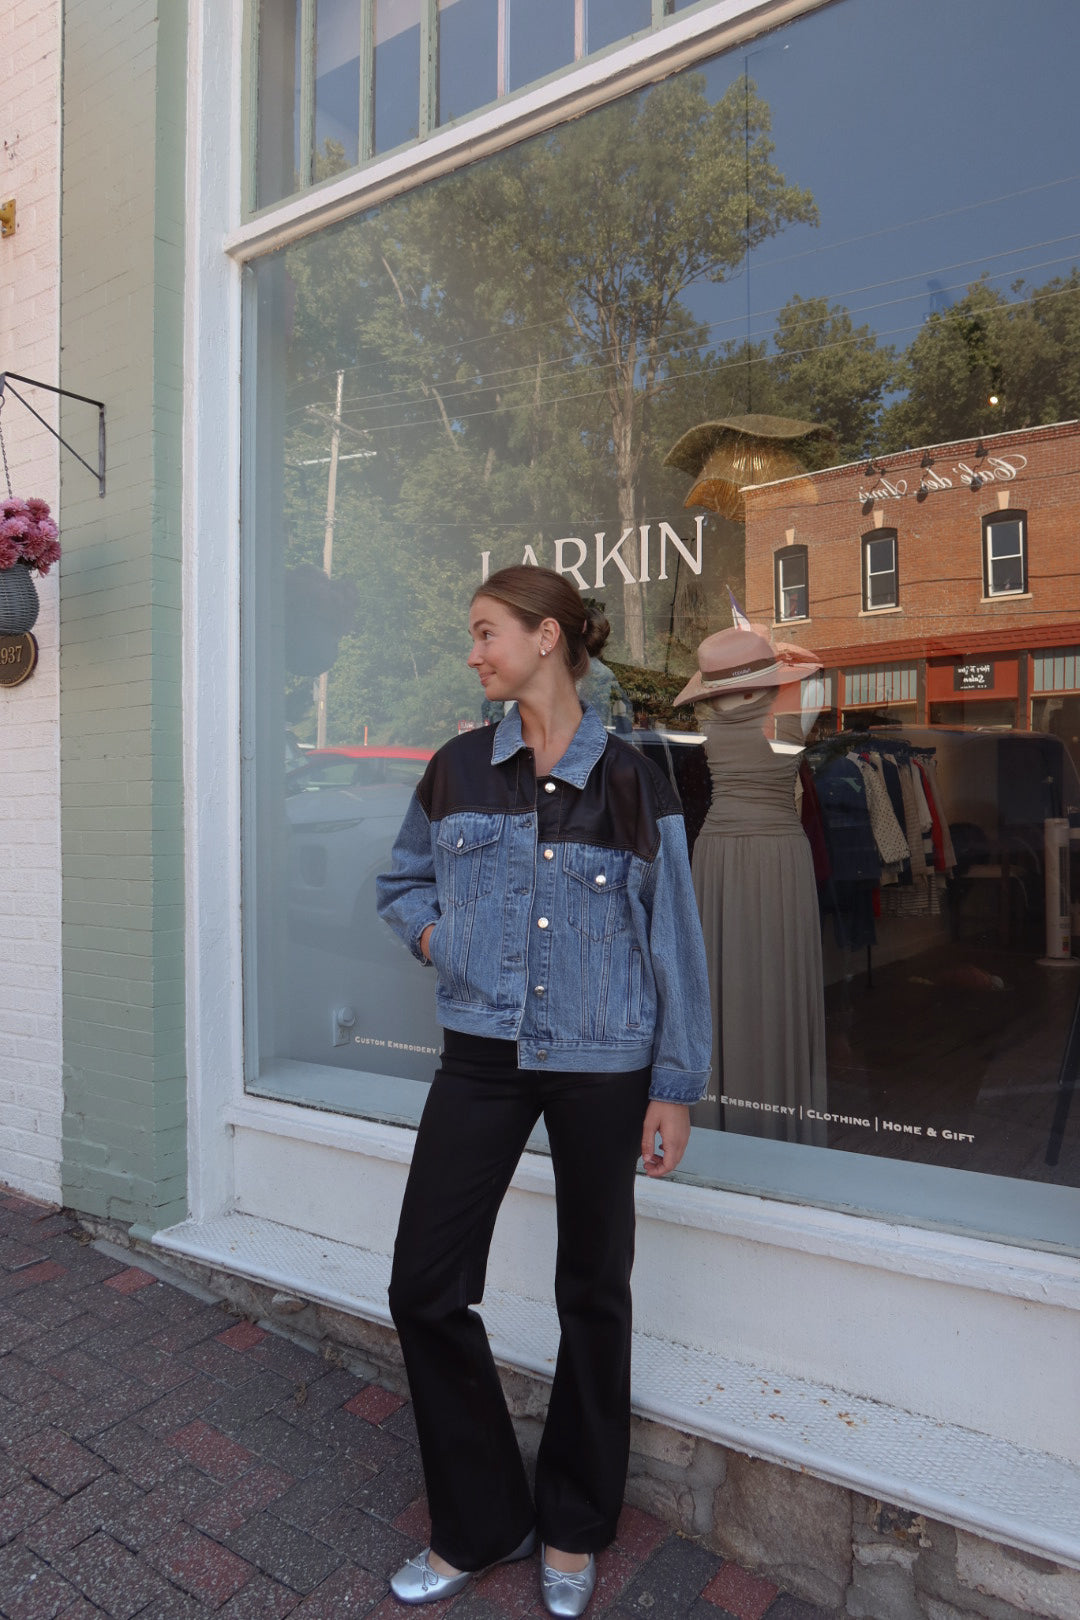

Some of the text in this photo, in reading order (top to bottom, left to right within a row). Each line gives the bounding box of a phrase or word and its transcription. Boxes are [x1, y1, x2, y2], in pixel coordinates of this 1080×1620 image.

[0, 645, 23, 665] 937
[720, 1095, 796, 1116] EMBROIDERY
[806, 1110, 871, 1127] CLOTHING
[882, 1120, 922, 1135] HOME
[926, 1127, 938, 1138] &
[942, 1129, 975, 1143] GIFT
